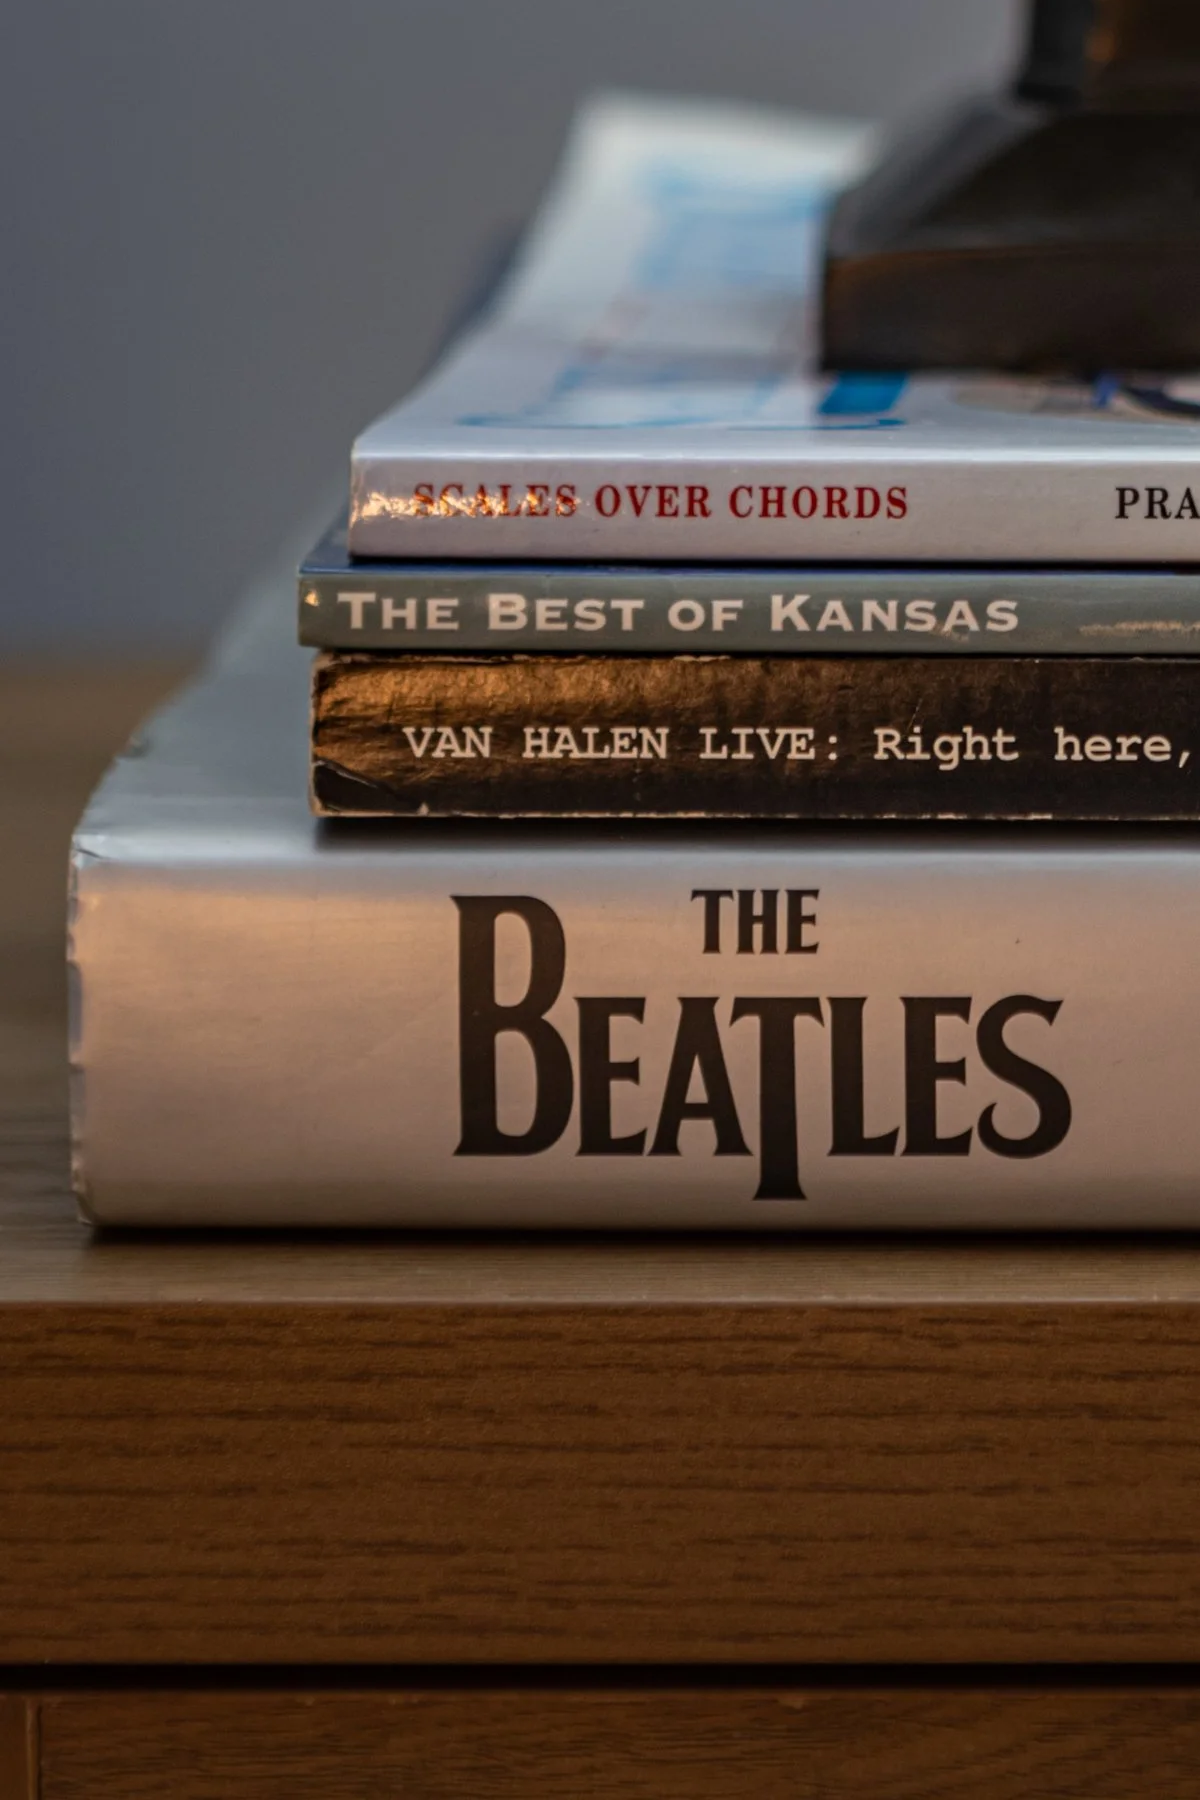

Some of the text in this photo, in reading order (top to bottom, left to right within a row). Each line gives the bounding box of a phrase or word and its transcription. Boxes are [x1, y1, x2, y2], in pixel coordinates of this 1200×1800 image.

[414, 484, 909, 521] SCALES OVER CHORDS
[338, 592, 1019, 633] THE BEST OF KANSAS
[402, 726, 492, 759] VAN
[522, 726, 669, 760] HALEN
[699, 727, 840, 761] LIVE:
[873, 726, 1019, 771] Right
[1054, 726, 1193, 768] here,
[691, 889, 820, 954] THE
[449, 894, 1073, 1200] BEATLES
